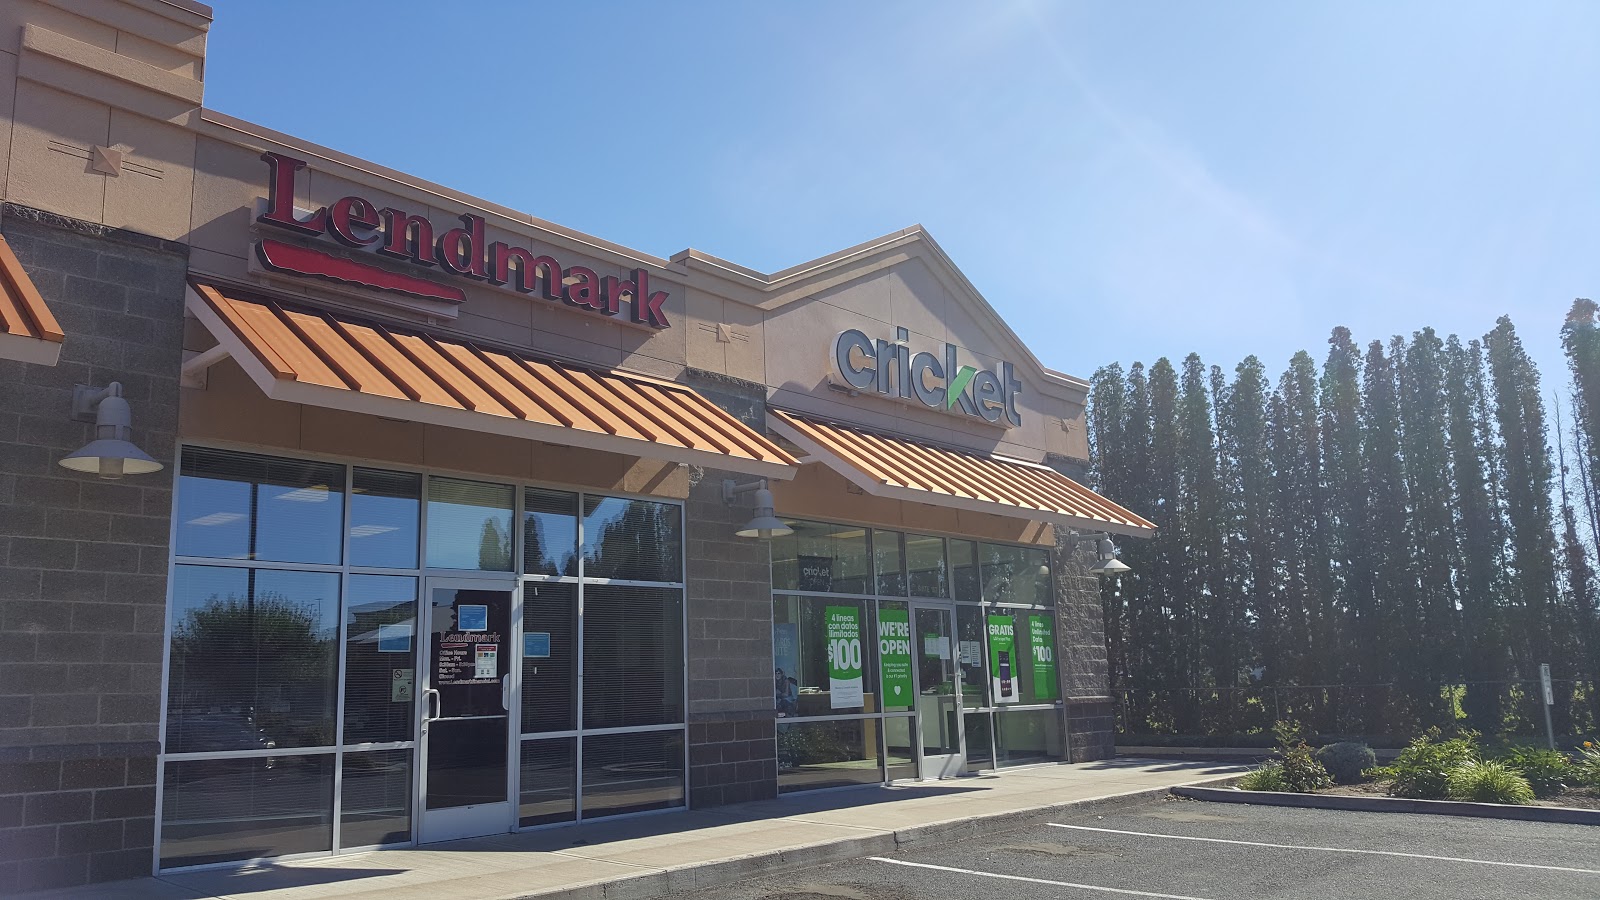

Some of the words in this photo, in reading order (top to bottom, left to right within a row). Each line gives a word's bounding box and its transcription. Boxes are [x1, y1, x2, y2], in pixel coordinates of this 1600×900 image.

[257, 151, 671, 330] Lendmark
[831, 326, 1021, 427] cricket
[831, 613, 836, 622] 4
[841, 621, 859, 630] datos
[879, 622, 909, 637] WE'RE
[989, 624, 1014, 636] GRATIS
[440, 631, 501, 643] Lendmark
[828, 629, 859, 638] ilimitados
[828, 638, 862, 670] $100
[880, 639, 911, 655] OPEN
[1033, 645, 1052, 662] $100
